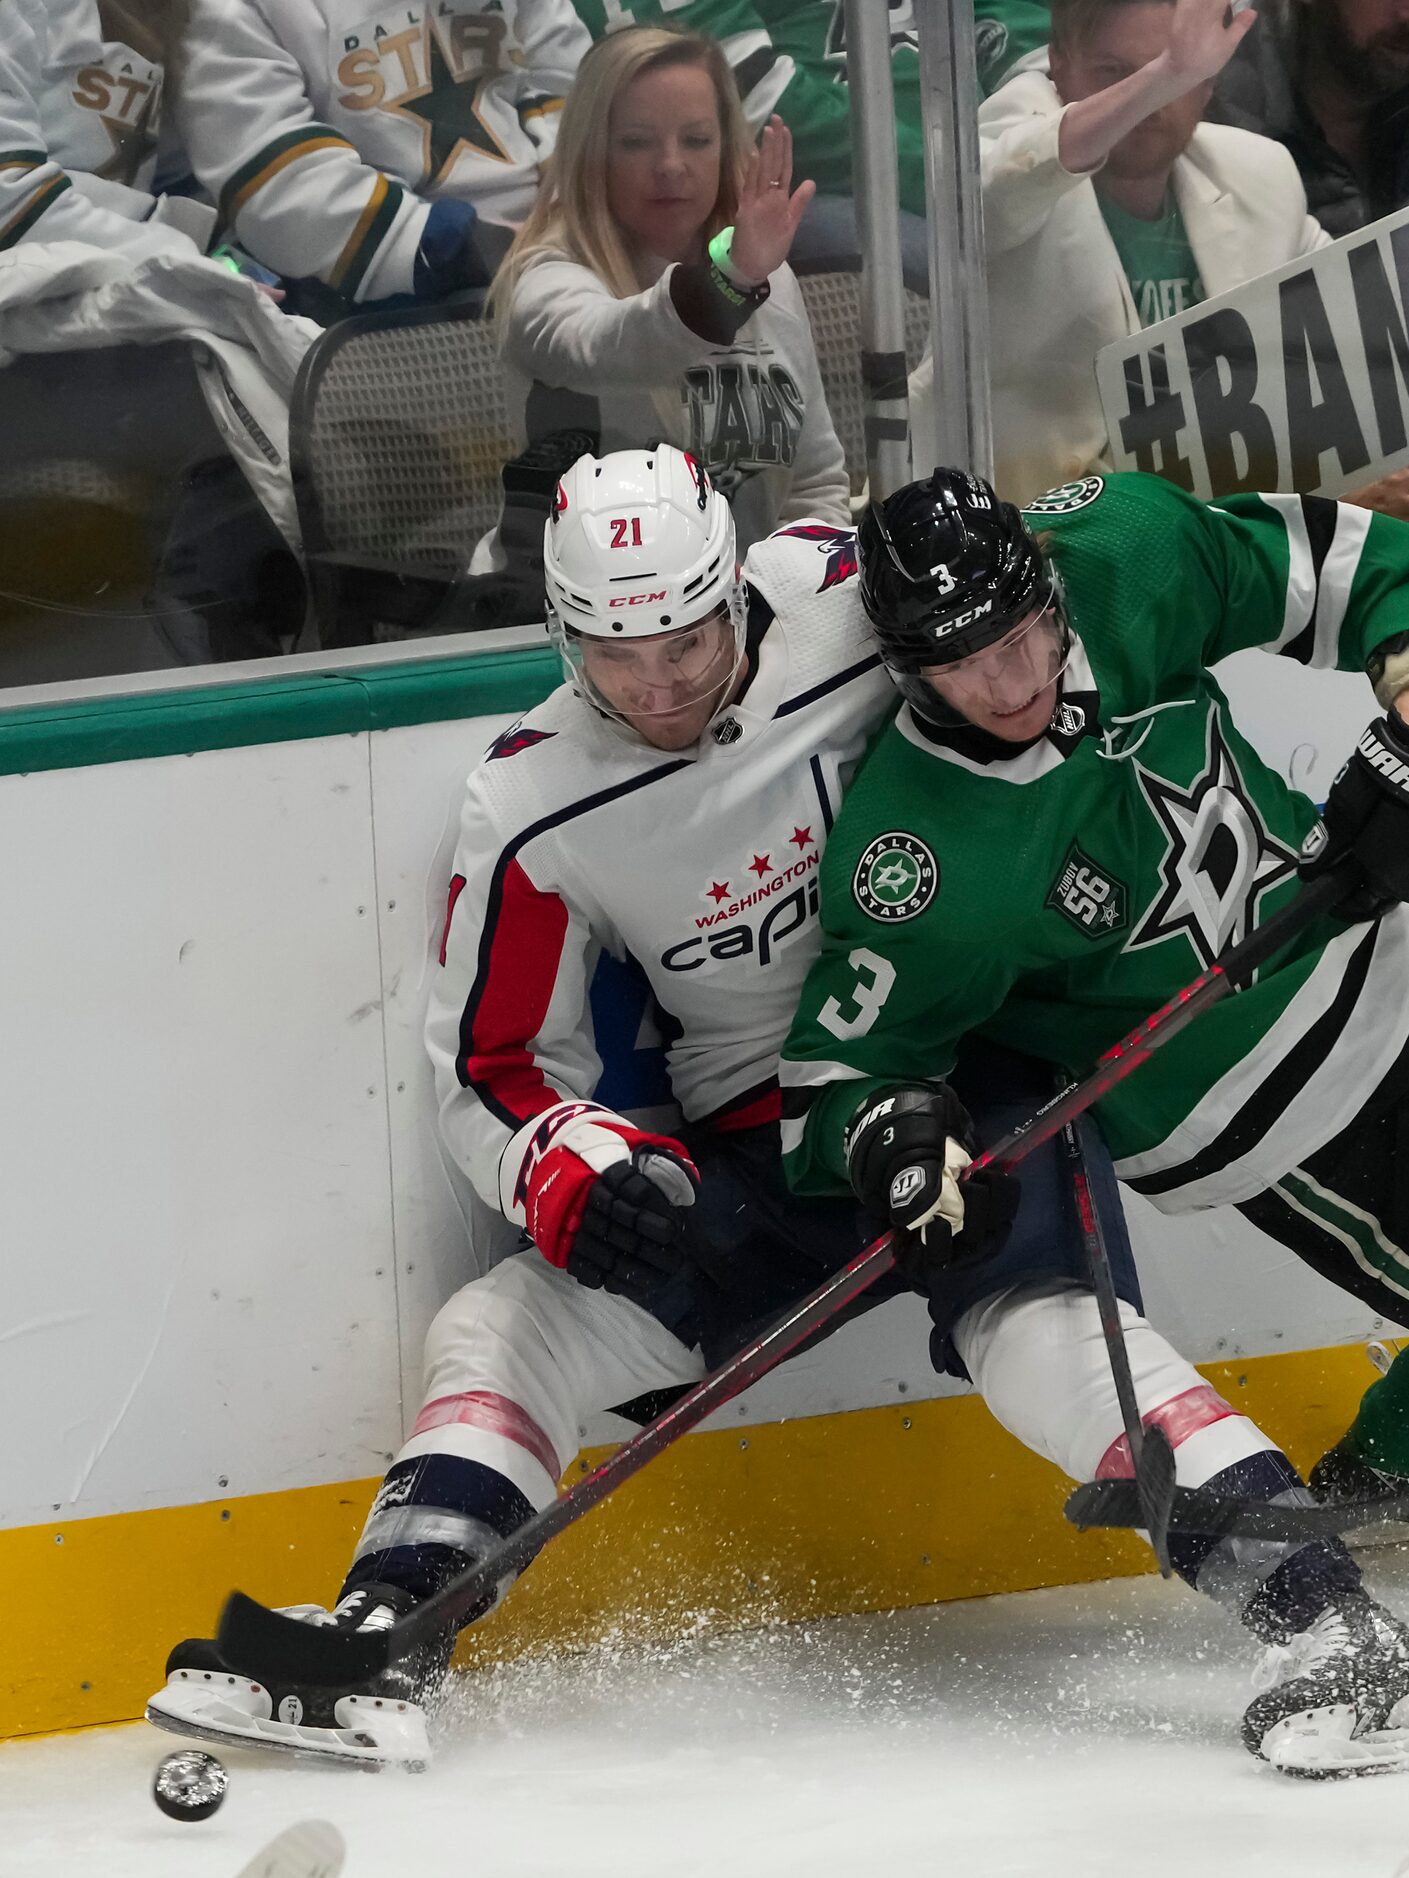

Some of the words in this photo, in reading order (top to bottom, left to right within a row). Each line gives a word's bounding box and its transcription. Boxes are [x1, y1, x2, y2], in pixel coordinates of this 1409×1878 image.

[610, 517, 643, 549] 21
[930, 563, 958, 596] 3
[608, 590, 668, 608] CCM
[935, 599, 993, 638] CCM
[863, 838, 933, 878] DALLAS
[695, 850, 820, 929] WASHINGTON
[1056, 861, 1079, 898] ZUBOV
[1063, 866, 1111, 926] 56
[859, 885, 921, 917] STARS
[816, 947, 897, 1042] 3
[882, 1126, 895, 1146] 3
